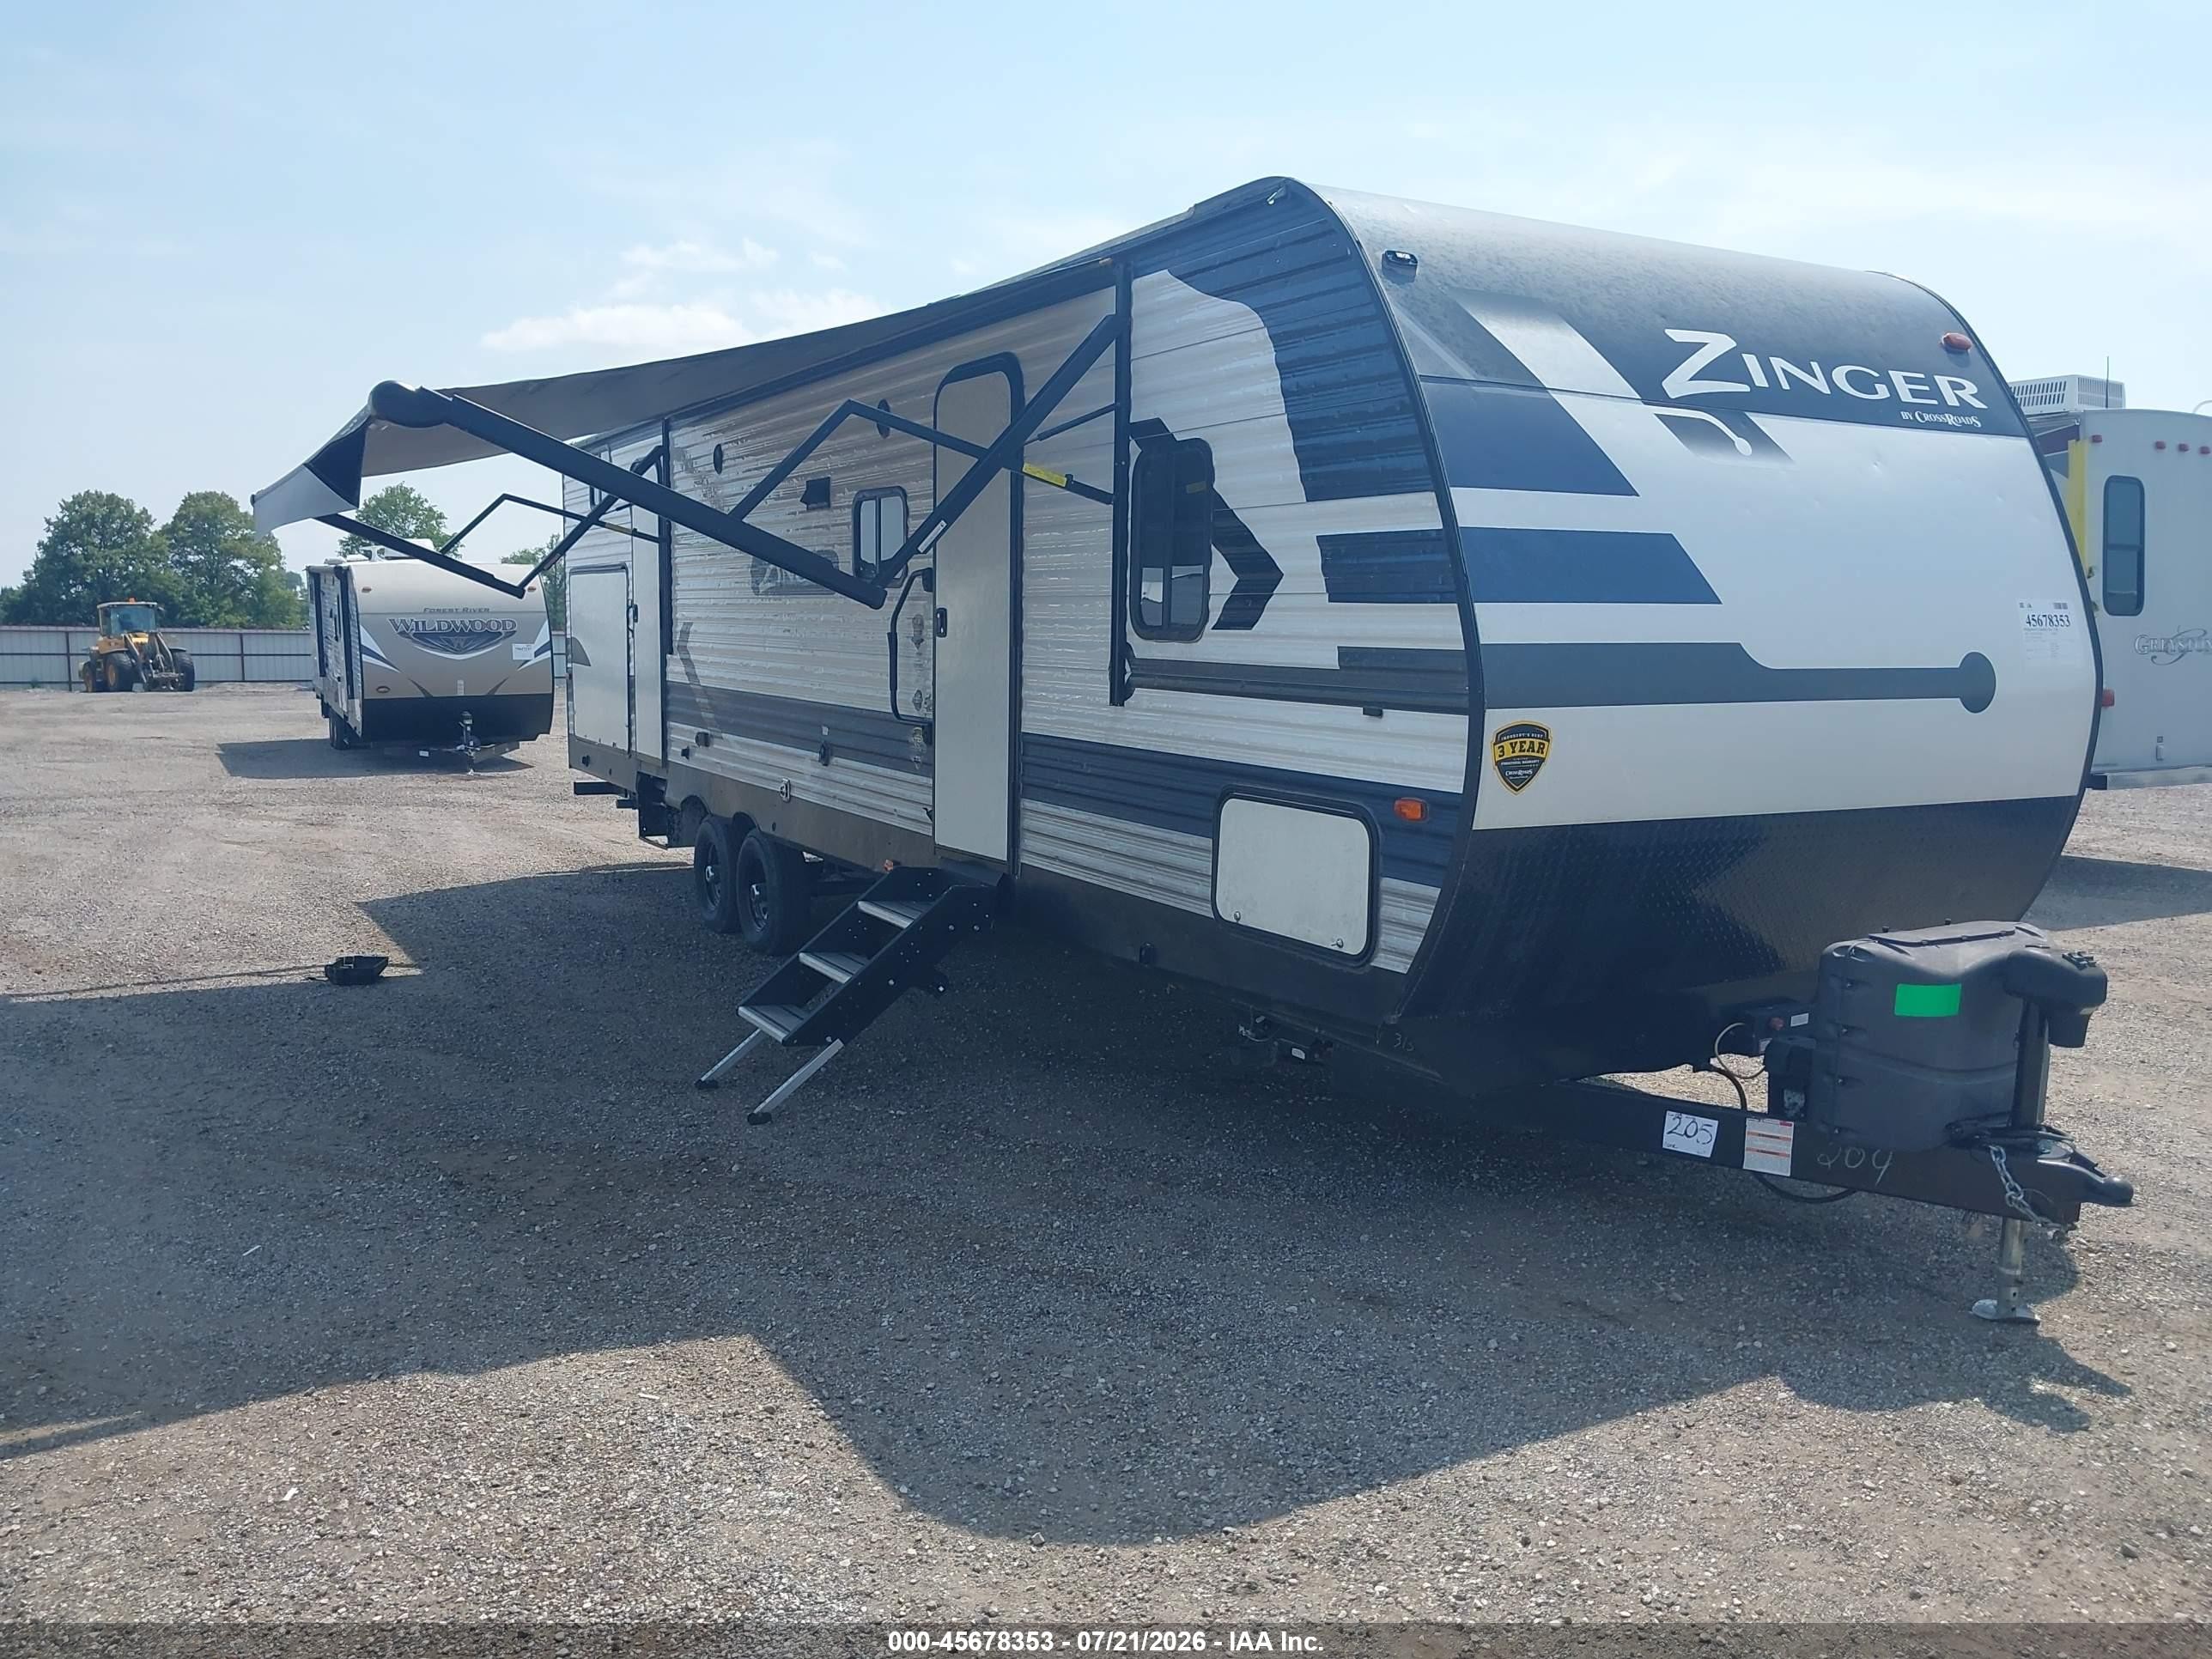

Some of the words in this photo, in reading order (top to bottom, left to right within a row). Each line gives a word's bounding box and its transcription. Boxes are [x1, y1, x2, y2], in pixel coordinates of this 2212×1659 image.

[1662, 328, 1989, 409] ZINGER
[1900, 410, 1913, 421] BY
[388, 617, 517, 633] WILDWOOD
[2026, 613, 2071, 628] 45678353
[1498, 745, 1505, 758] 3
[1509, 740, 1546, 755] YEAR
[1665, 1113, 1714, 1146] 205
